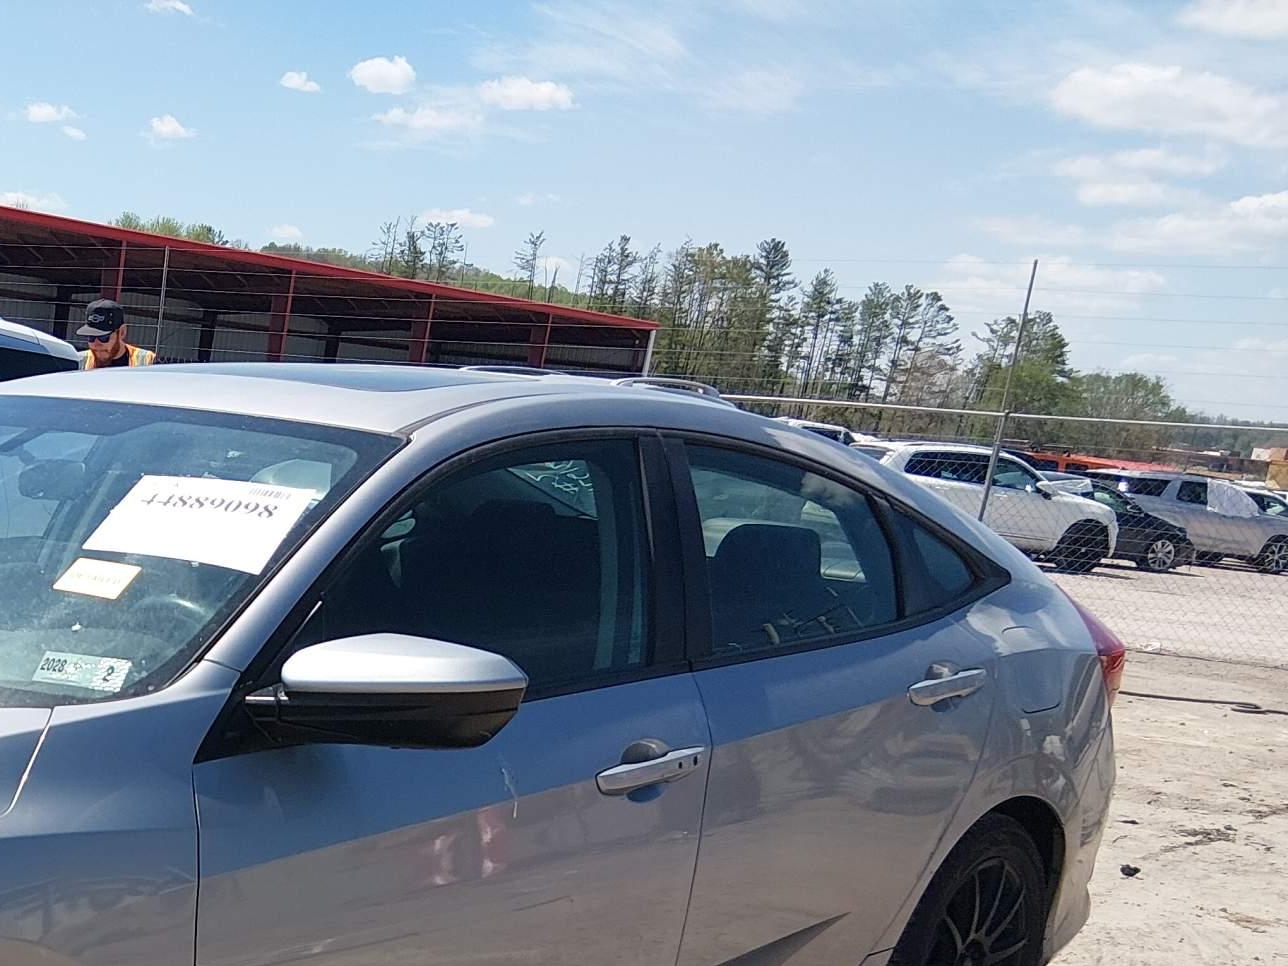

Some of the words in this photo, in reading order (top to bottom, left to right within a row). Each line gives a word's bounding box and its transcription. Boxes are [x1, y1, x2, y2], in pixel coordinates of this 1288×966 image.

[140, 493, 279, 519] 44889098
[40, 657, 68, 673] 2028
[102, 665, 115, 683] 2
